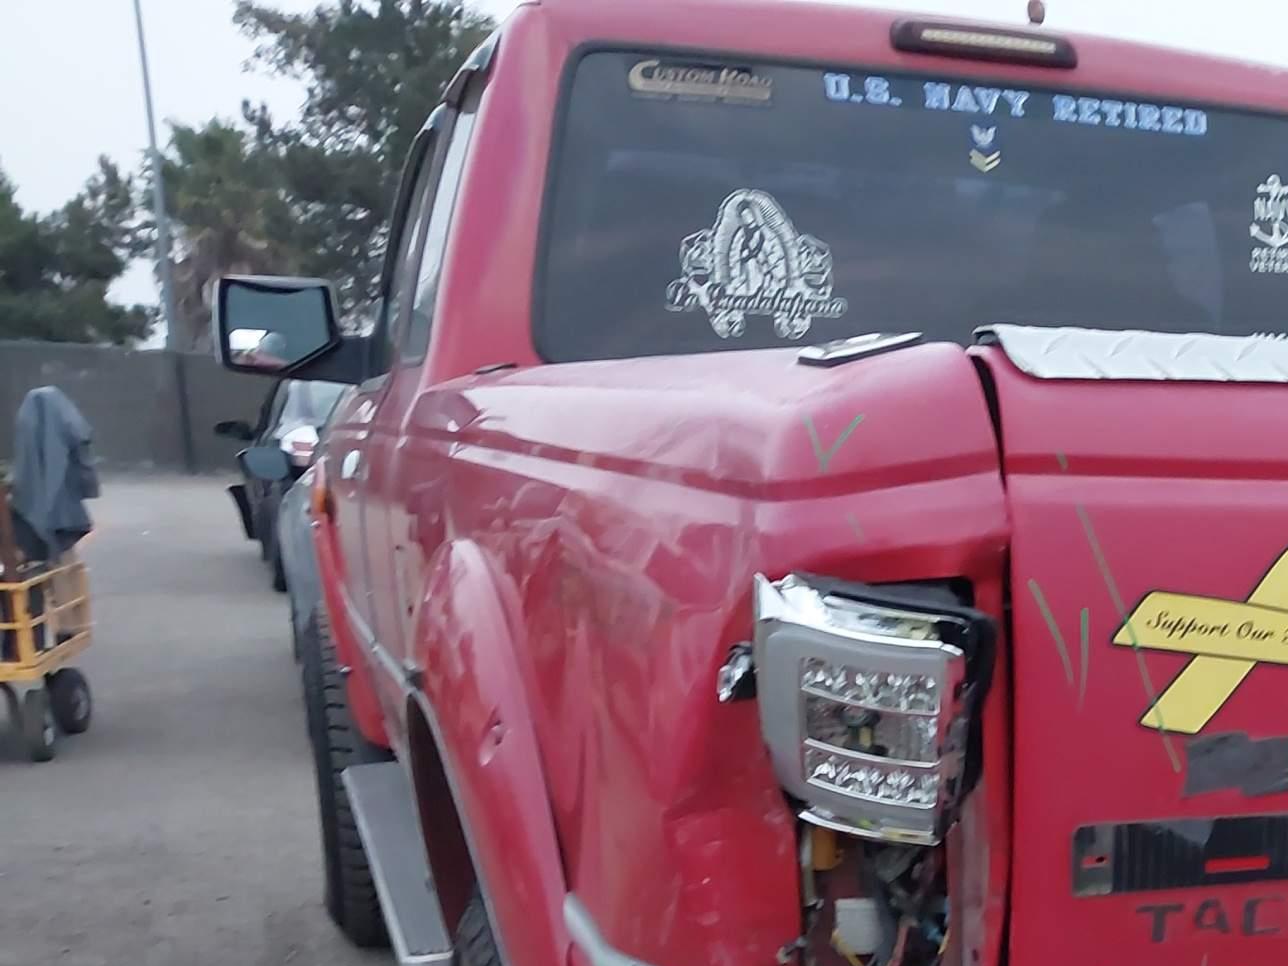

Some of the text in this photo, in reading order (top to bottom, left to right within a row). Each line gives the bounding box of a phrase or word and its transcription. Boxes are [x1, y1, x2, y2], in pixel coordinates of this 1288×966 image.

[823, 72, 1208, 135] U.S. NAVY RETIRED
[1146, 610, 1231, 640] Support
[1236, 620, 1276, 643] Our
